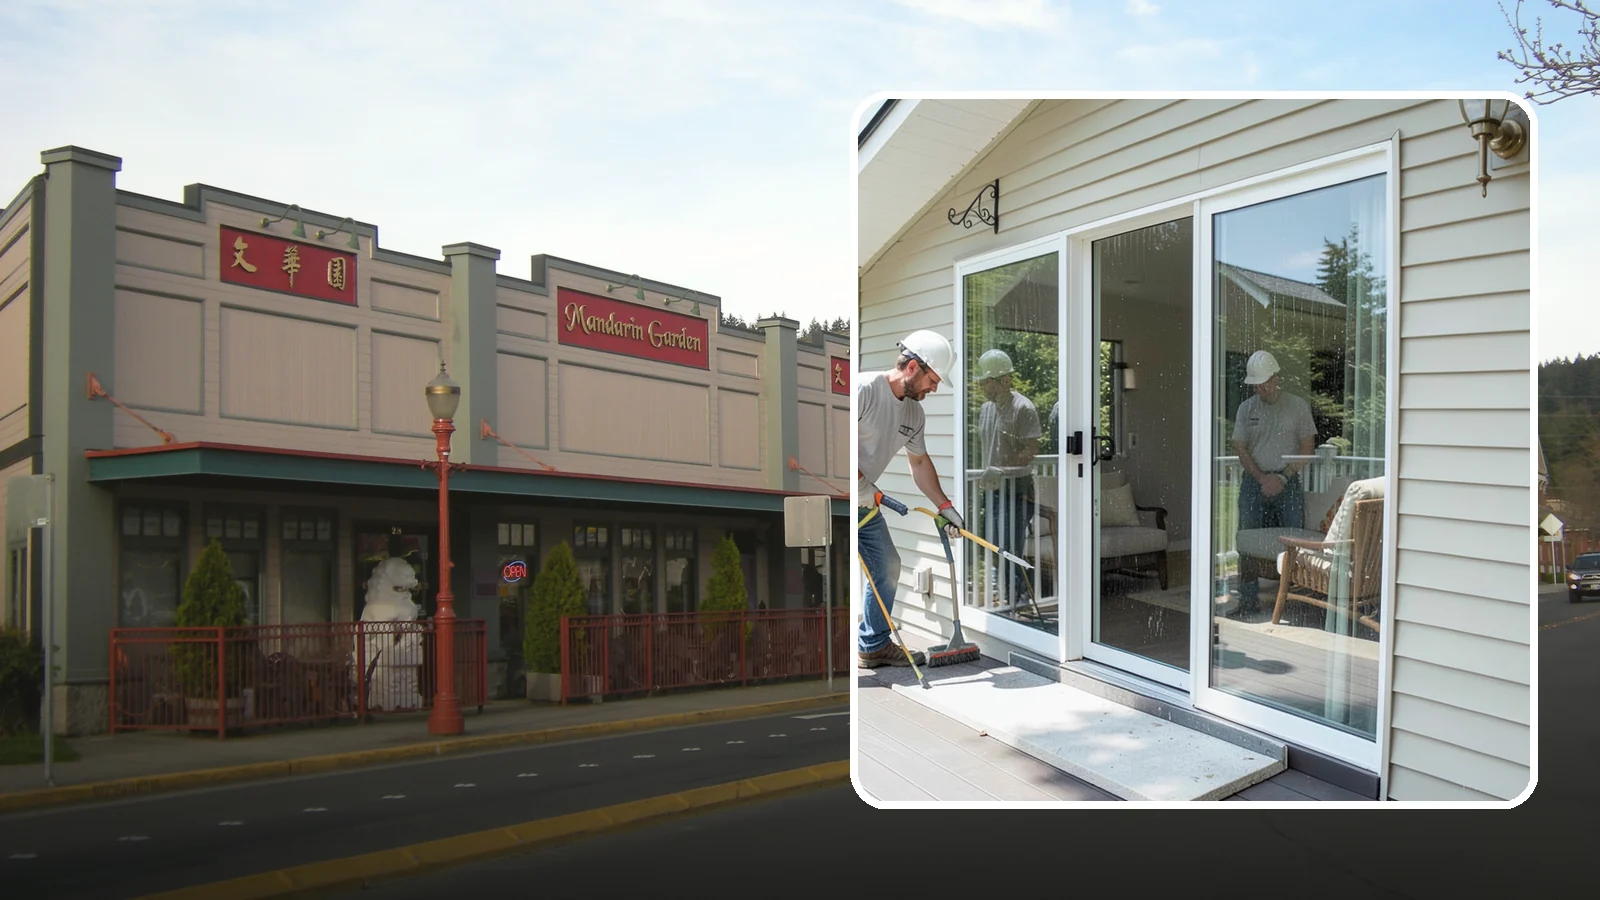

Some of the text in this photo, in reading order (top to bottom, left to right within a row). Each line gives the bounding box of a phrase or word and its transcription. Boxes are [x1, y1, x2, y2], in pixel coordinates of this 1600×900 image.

[230, 235, 346, 291] 文華園
[564, 302, 702, 352] Mandarin Garden
[503, 565, 527, 578] OPEN
